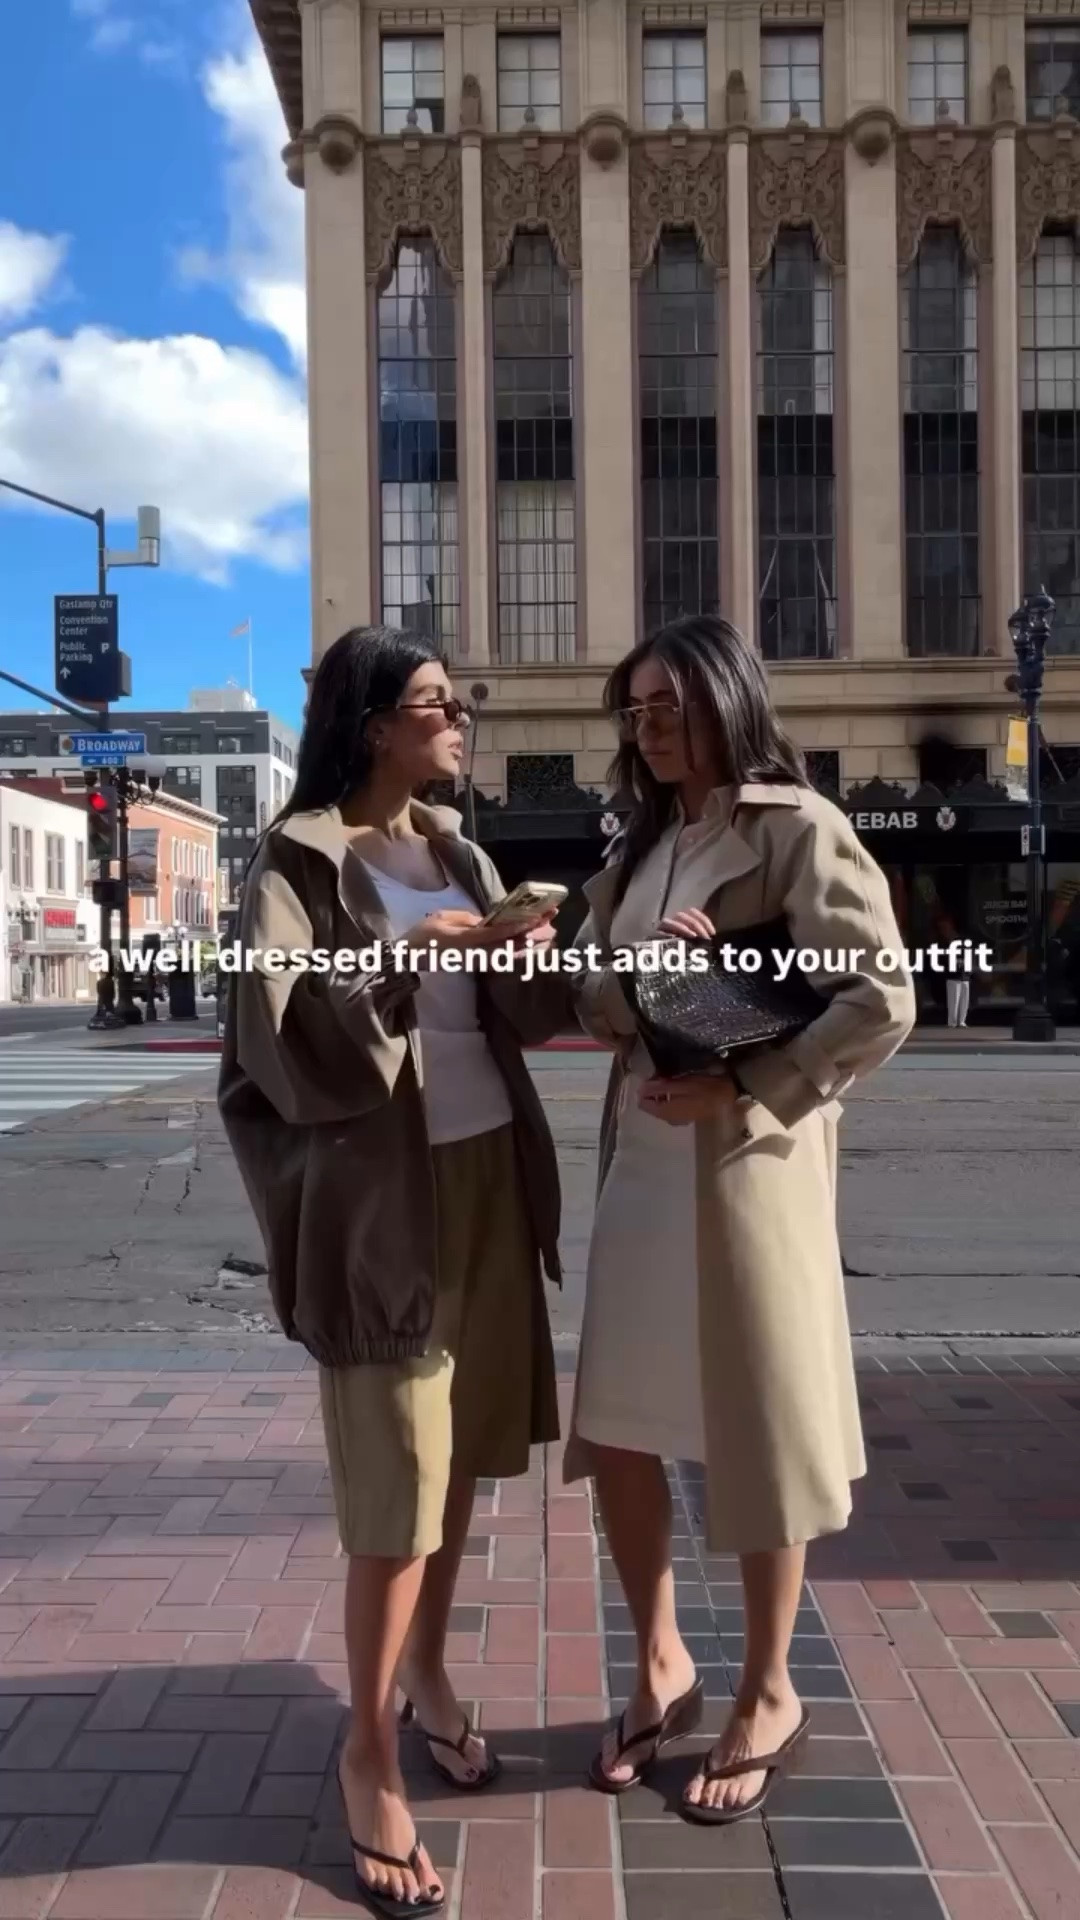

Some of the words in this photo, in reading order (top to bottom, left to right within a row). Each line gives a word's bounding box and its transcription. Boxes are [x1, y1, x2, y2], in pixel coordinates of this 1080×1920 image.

[60, 600, 97, 610] Gaslamp
[99, 600, 113, 609] Qtr
[60, 615, 109, 625] Convention
[60, 627, 88, 636] Center
[60, 642, 86, 650] Public
[101, 643, 110, 653] P
[60, 652, 93, 664] Parking
[77, 738, 141, 752] BROADWAY
